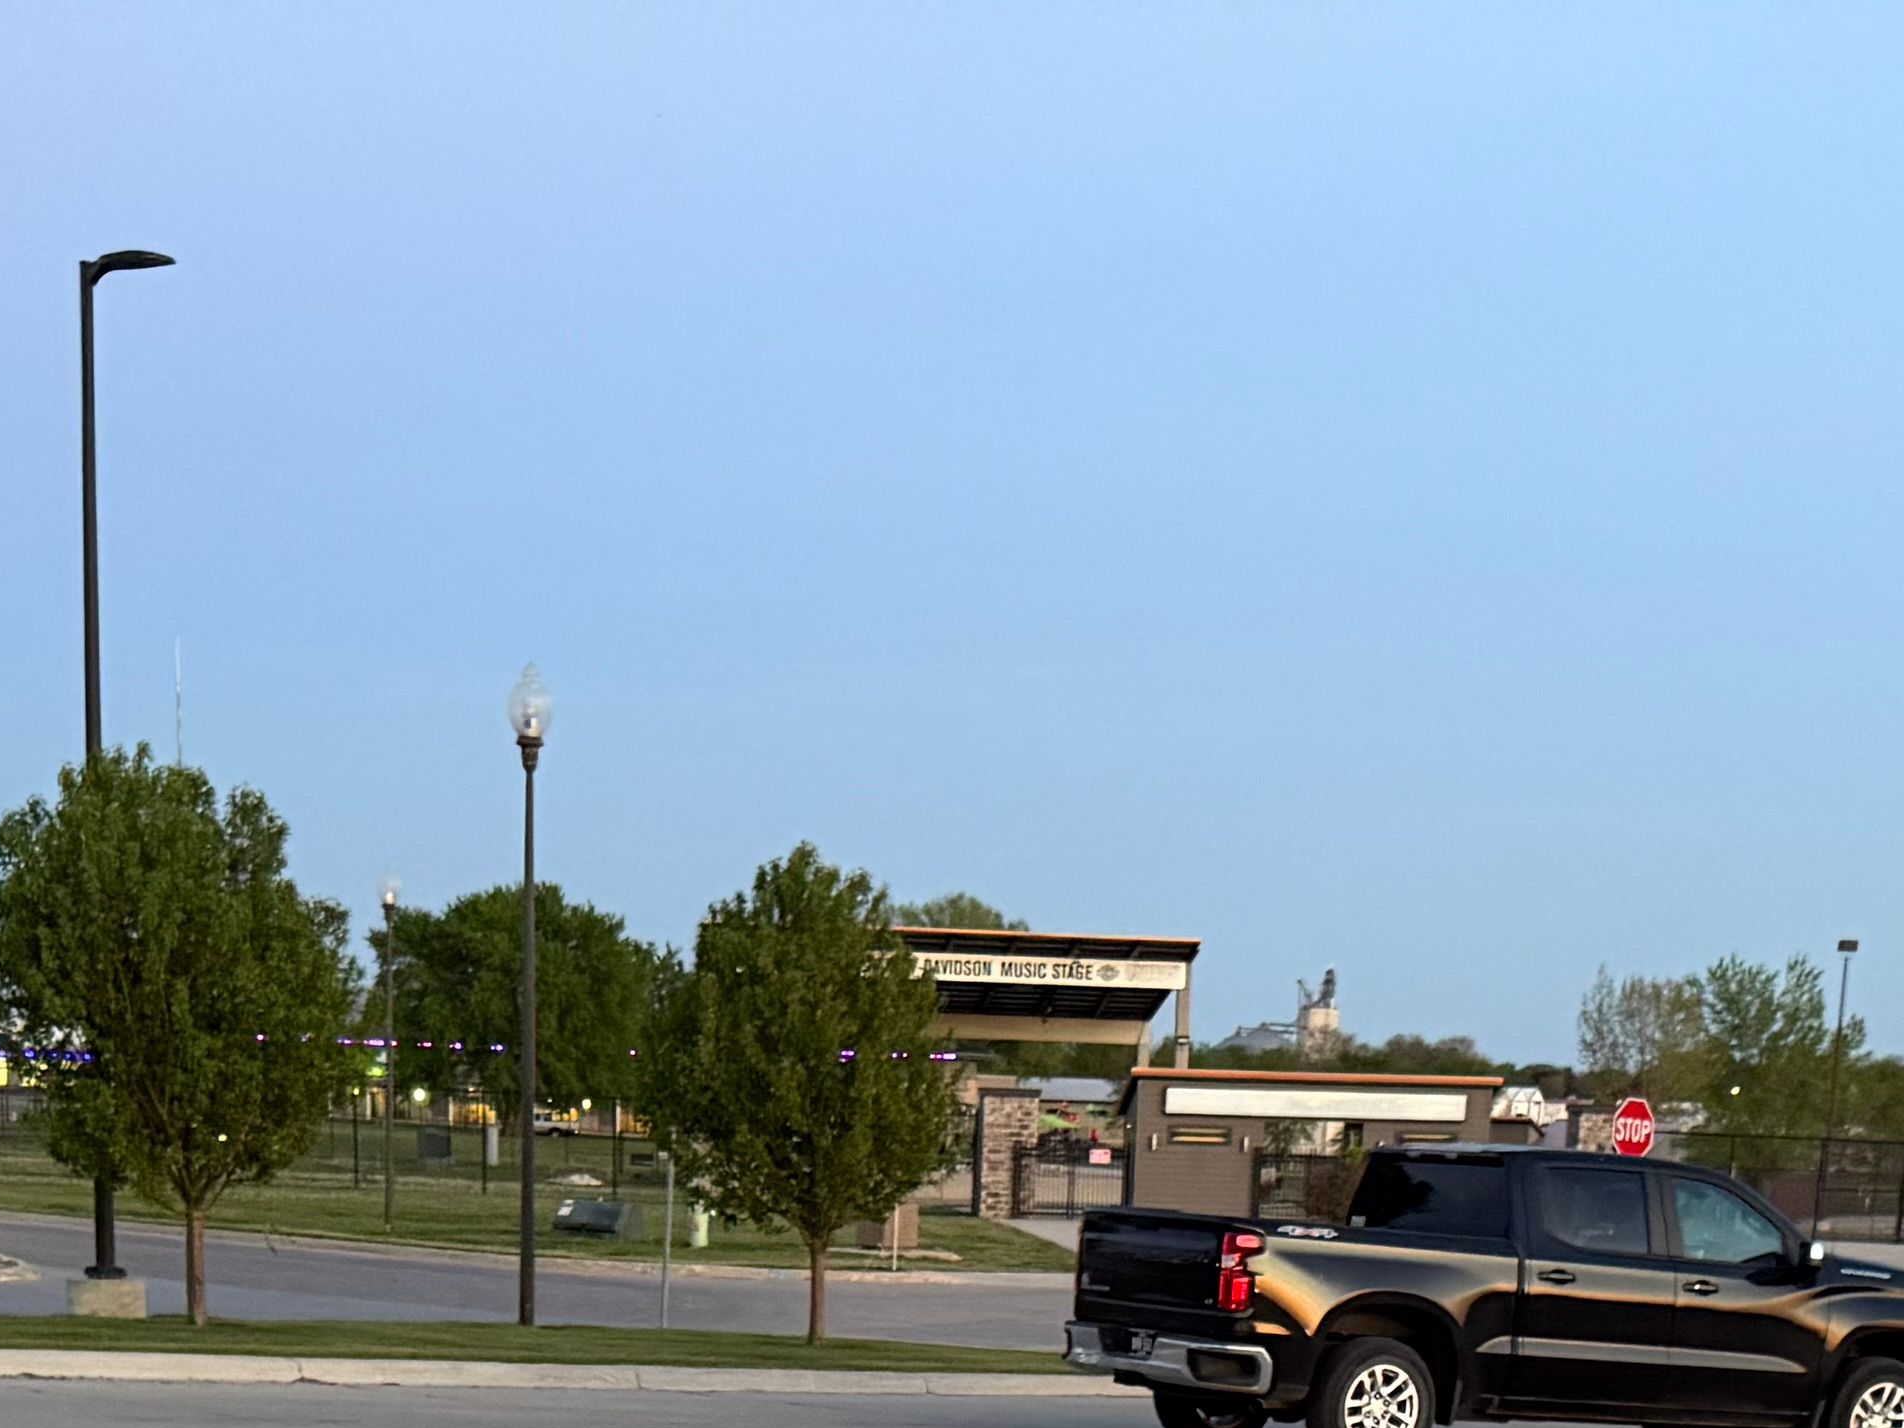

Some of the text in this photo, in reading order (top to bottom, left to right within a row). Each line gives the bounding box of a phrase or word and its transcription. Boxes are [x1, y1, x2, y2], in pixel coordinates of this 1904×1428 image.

[1000, 961, 1047, 979] MUSIC
[1052, 963, 1094, 981] STAGE
[1616, 1117, 1651, 1143] STOP
